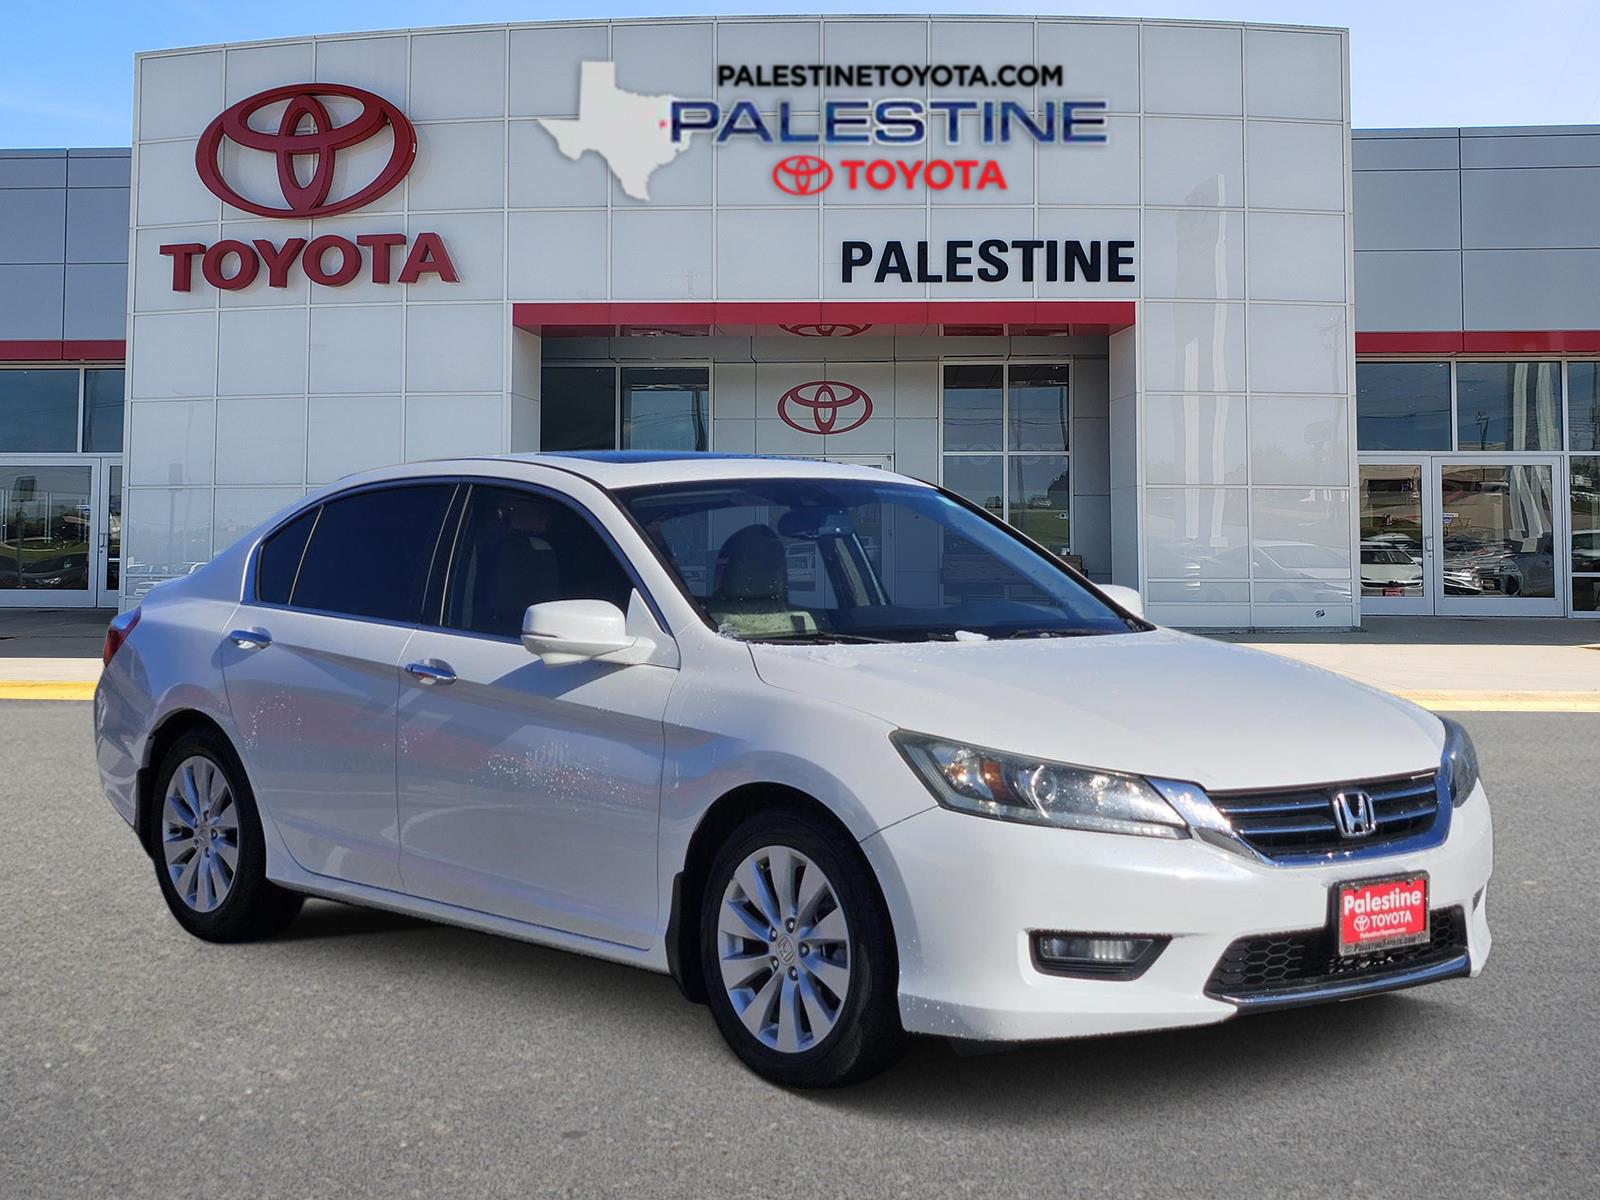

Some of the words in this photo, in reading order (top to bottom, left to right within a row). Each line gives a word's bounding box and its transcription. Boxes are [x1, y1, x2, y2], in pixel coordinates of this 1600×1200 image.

[159, 232, 461, 292] TOYOTA
[841, 239, 1135, 284] PALESTINE
[1344, 888, 1421, 915] Palestine
[1370, 910, 1413, 928] TOYOTA
